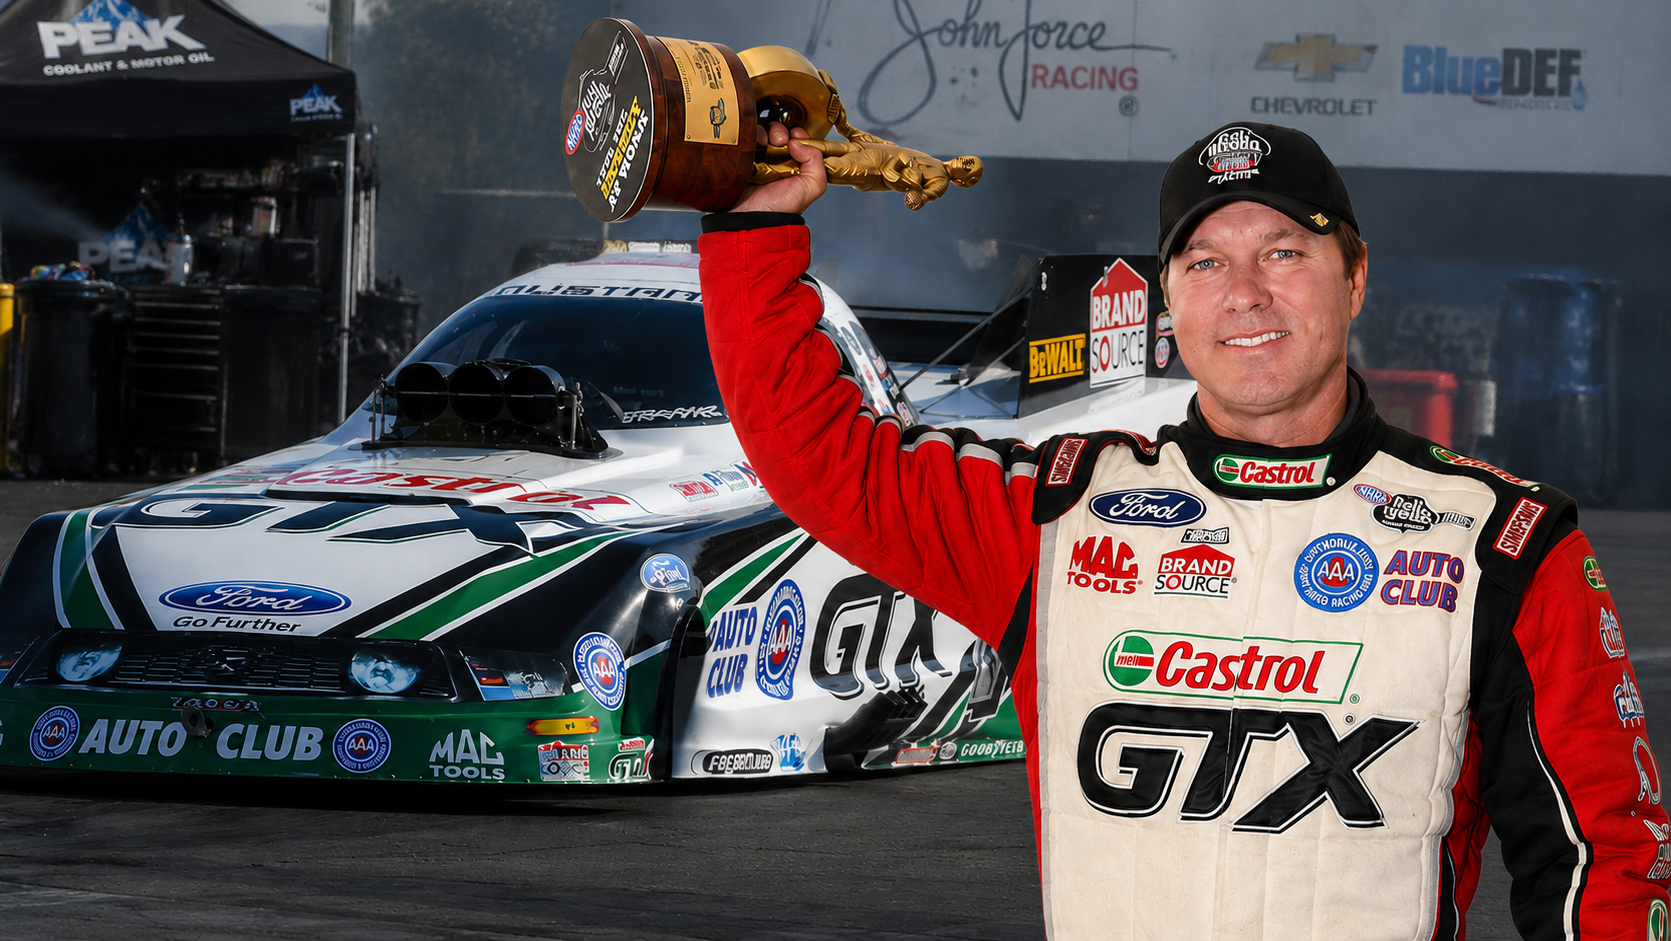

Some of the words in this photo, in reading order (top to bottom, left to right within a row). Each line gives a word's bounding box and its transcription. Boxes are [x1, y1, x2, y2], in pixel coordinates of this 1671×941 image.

[37, 14, 207, 58] PEAK
[43, 60, 112, 76] COOLANT
[116, 58, 129, 71] &
[131, 55, 185, 69] MOTOR
[188, 52, 215, 64] OIL
[1031, 64, 1139, 91] RACING
[1402, 45, 1582, 96] BlueDEF
[289, 95, 343, 116] PEAK
[1251, 96, 1376, 116] CHEVROLET
[1092, 289, 1146, 332] BRAND
[1091, 330, 1144, 374] SOURCE
[1239, 461, 1317, 484] Castrol
[1068, 535, 1139, 579] MAC
[1160, 557, 1233, 576] BRAND
[1317, 560, 1355, 581] AAA
[1383, 549, 1465, 584] AUTO
[1067, 571, 1137, 594] TOOLS
[1155, 574, 1231, 595] SOURCE
[1380, 579, 1459, 613] CLUB
[195, 584, 306, 613] Ford
[172, 616, 194, 629] Go
[196, 616, 302, 633] Further
[712, 607, 758, 653] AUTO
[767, 623, 793, 657] AAA
[809, 574, 953, 700] GTX
[592, 656, 615, 679] AAA
[706, 653, 749, 699] CLUB
[1155, 640, 1326, 694] Castrol
[42, 725, 66, 739] AAA
[78, 718, 187, 757] AUTO
[216, 723, 324, 761] CLUB
[347, 737, 375, 752] AAA
[429, 729, 505, 765] MAC
[430, 764, 505, 780] TOOLS
[1077, 701, 1424, 834] GTX
